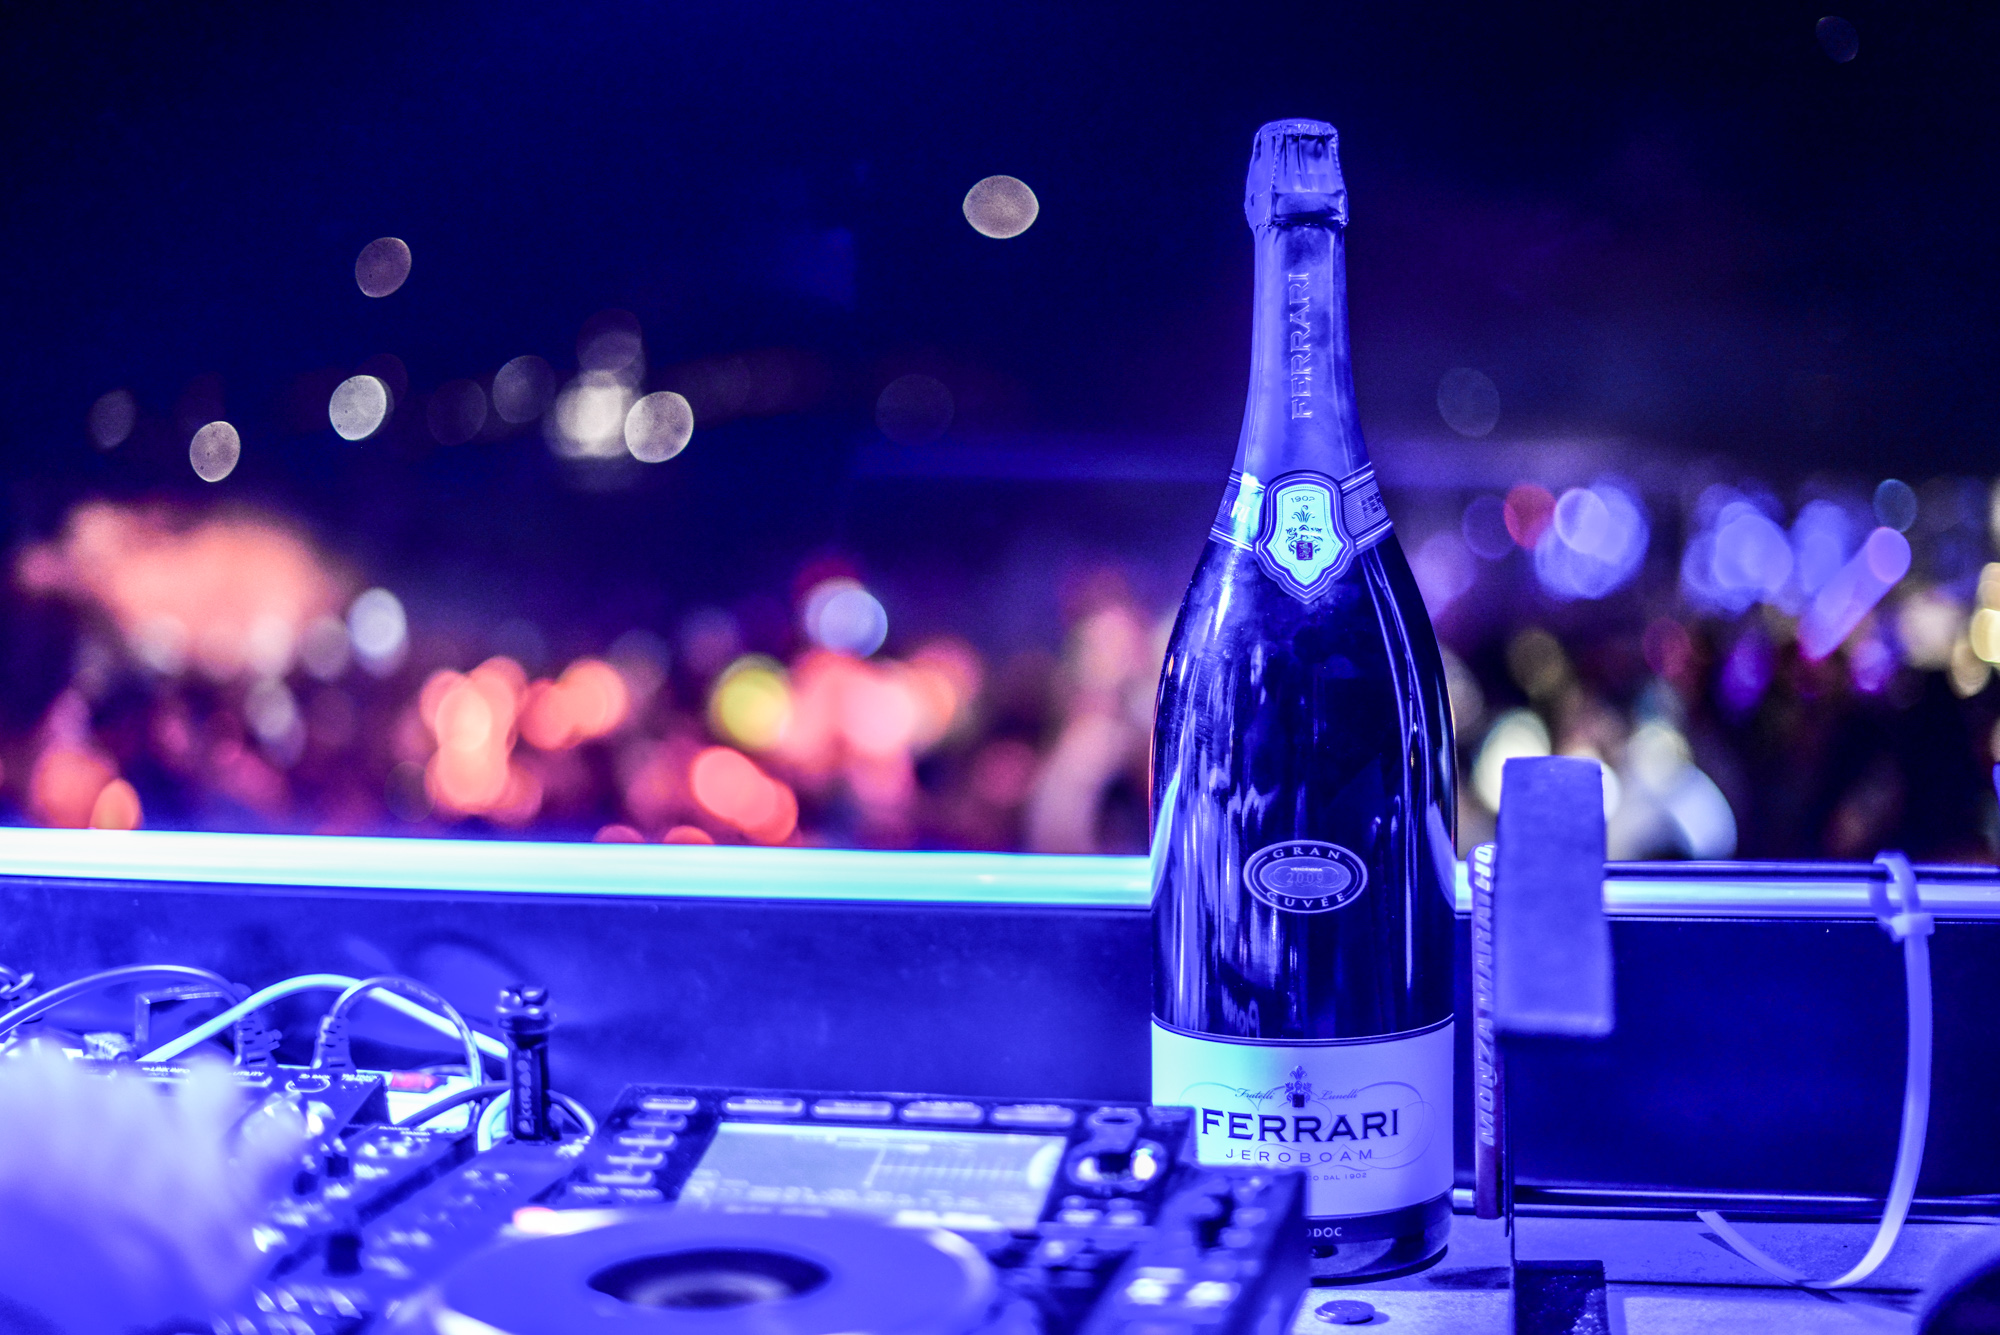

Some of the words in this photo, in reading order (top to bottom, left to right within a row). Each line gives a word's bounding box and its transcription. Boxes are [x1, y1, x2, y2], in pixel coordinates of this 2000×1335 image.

[1289, 272, 1312, 420] FERRARI
[1290, 495, 1316, 504] 1902
[1272, 846, 1341, 860] GRAN
[1285, 872, 1325, 884] 2009
[1474, 844, 1497, 1012] MARATHO
[1476, 1020, 1497, 1147] MONZA
[1234, 1087, 1276, 1100] Fratelli
[1318, 1088, 1360, 1101] Lunelli
[1201, 1107, 1400, 1143] FERRARI
[1225, 1148, 1373, 1163] JEROBOAM
[1344, 1172, 1368, 1180] 1902
